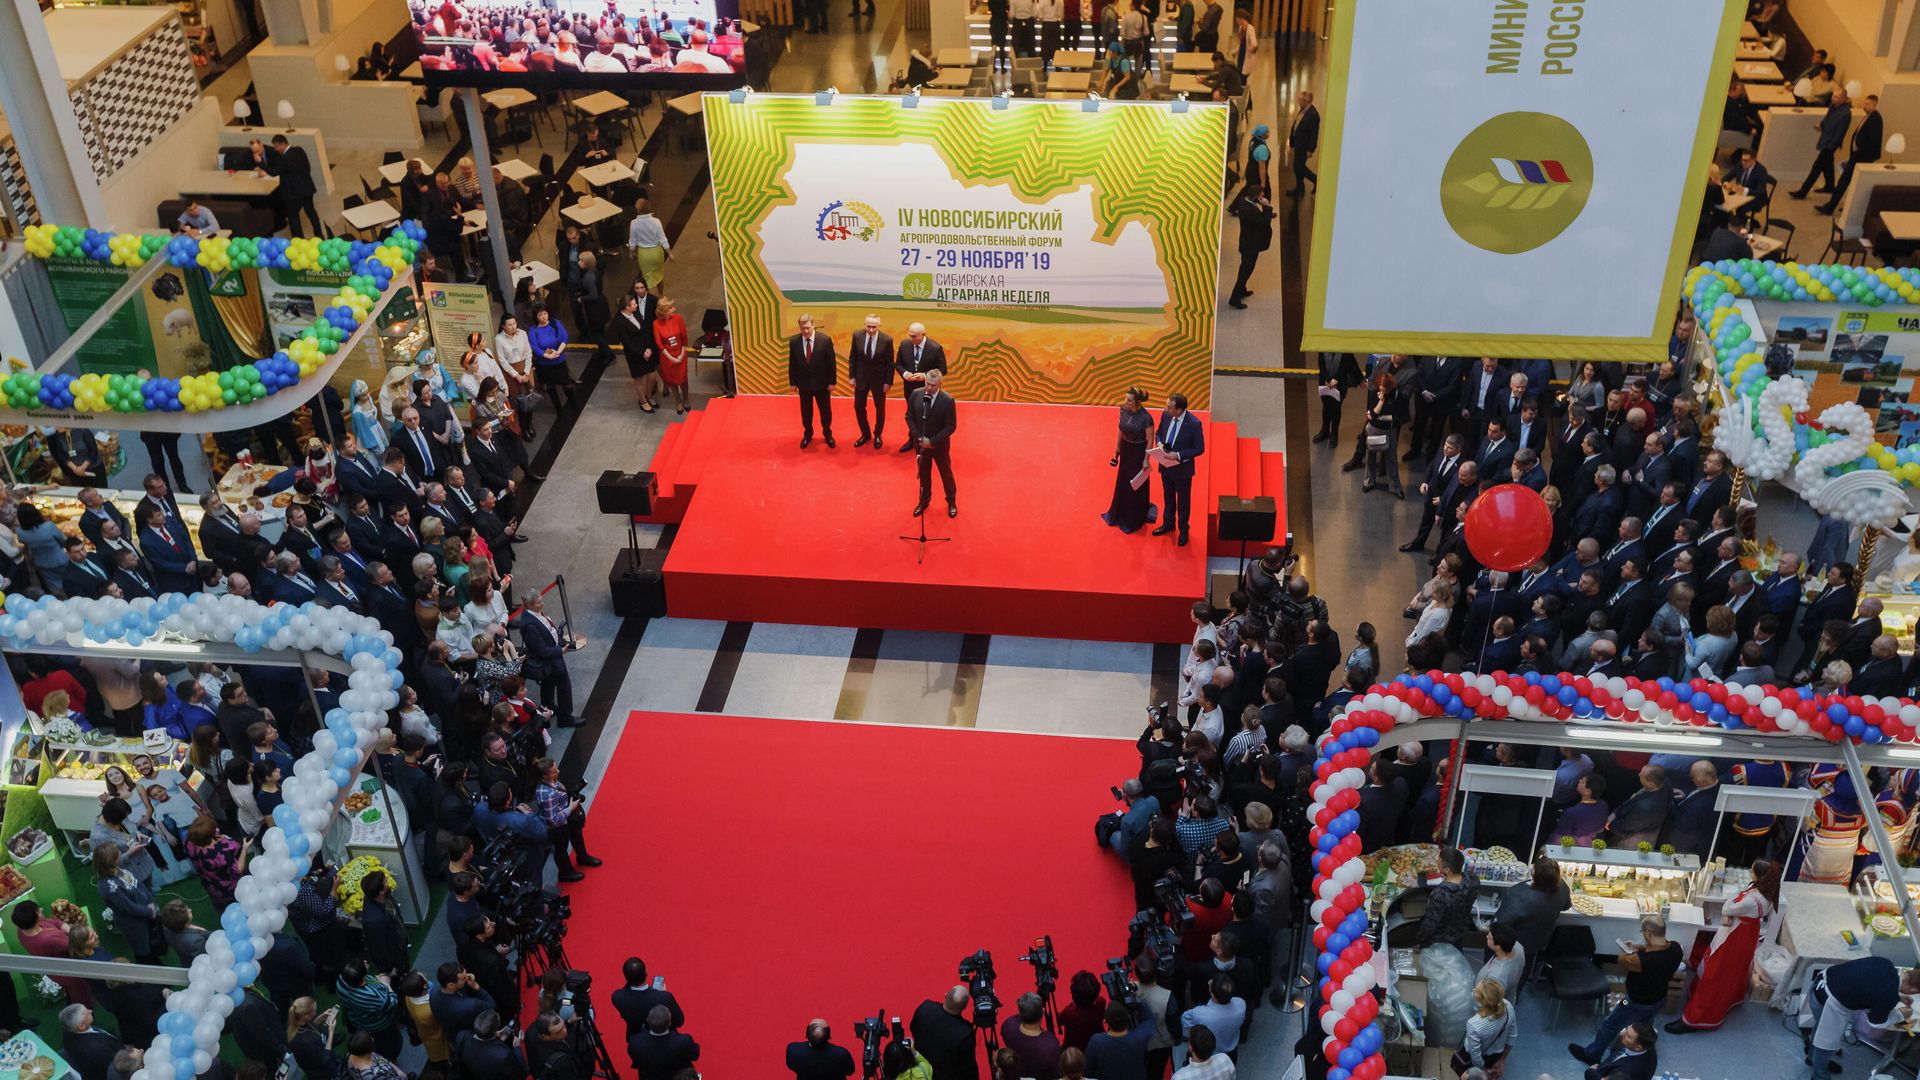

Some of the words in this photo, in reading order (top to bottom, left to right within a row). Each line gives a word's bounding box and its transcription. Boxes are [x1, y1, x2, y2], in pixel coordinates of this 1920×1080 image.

[1541, 0, 1586, 75] РОСС
[898, 208, 914, 227] IV
[918, 208, 1063, 231] НОВОСИБИРСКИЙ
[900, 233, 1027, 247] АГРОПРОДОВОЛЬСТВЕННЫЙ
[1028, 236, 1063, 247] ФОРУМ
[900, 248, 921, 266] 27
[936, 249, 957, 267] 29
[936, 272, 1005, 288] СИБИРСКАЯ
[937, 288, 998, 302] АГРАРНАЯ
[1002, 290, 1050, 304] НЕДЕЛЯ
